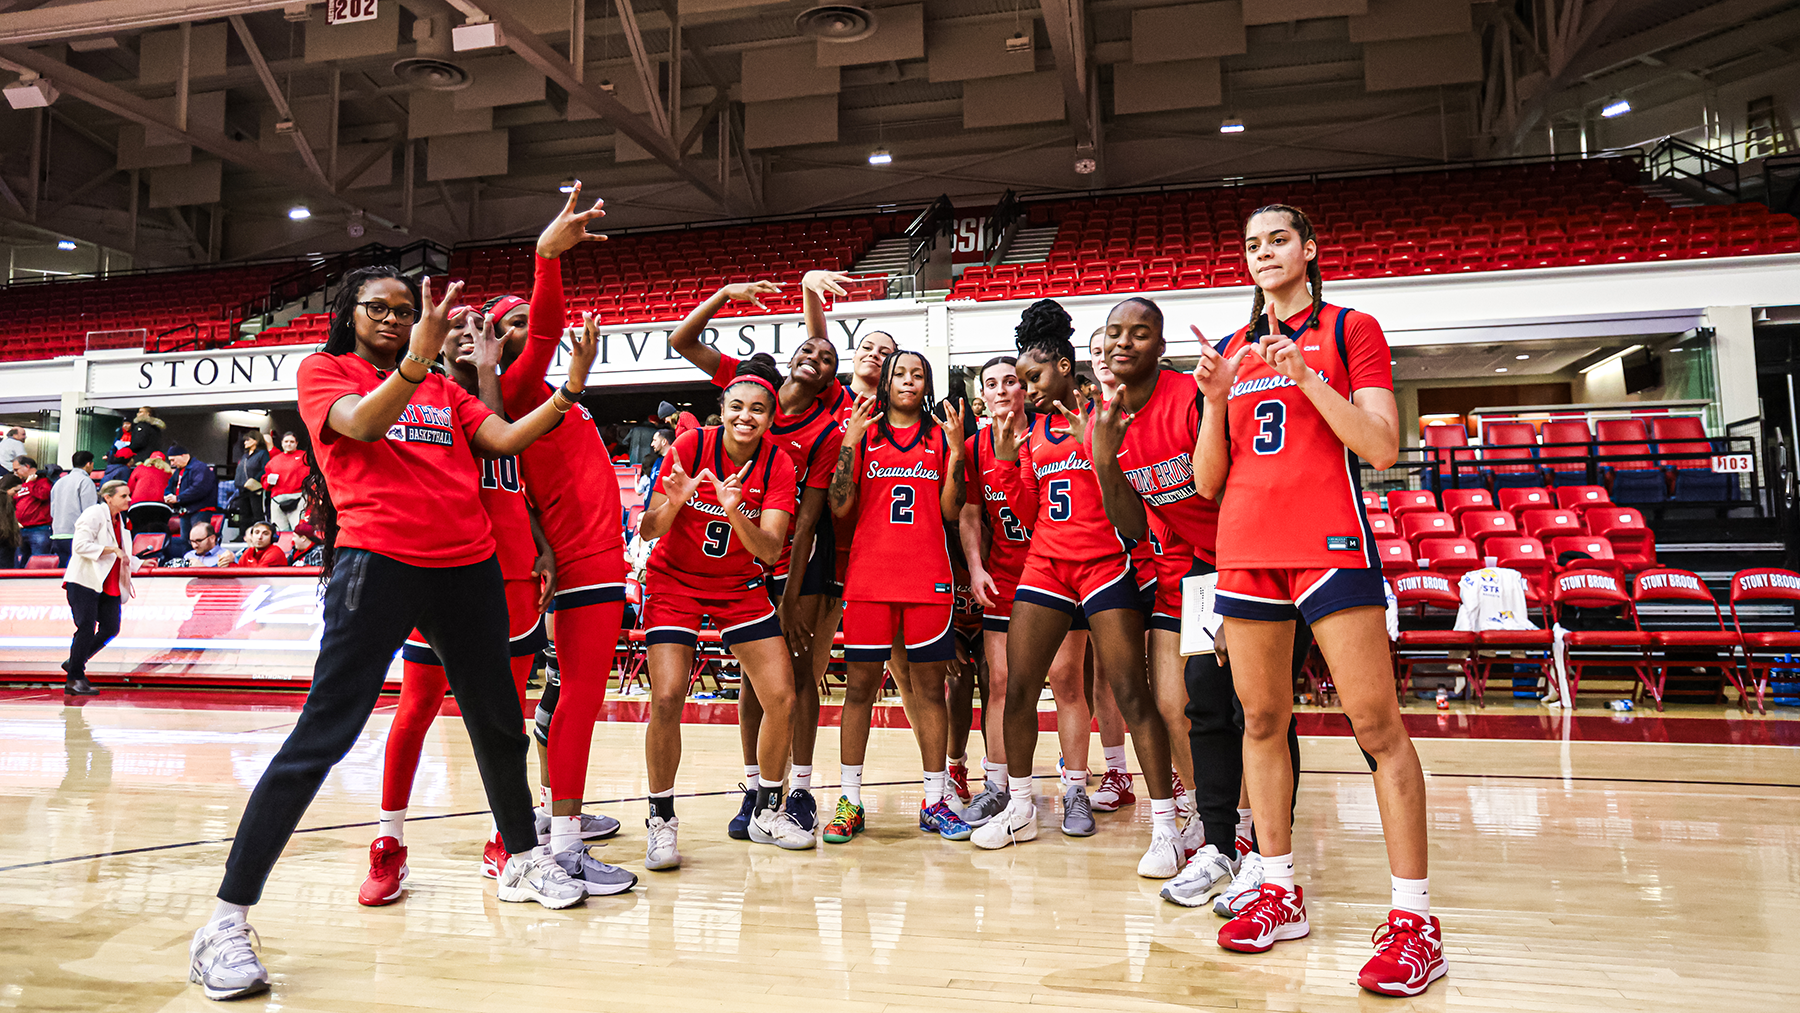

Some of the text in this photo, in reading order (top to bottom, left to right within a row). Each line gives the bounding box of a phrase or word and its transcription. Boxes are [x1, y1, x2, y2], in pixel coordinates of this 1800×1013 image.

[336, 0, 375, 19] 202
[138, 354, 287, 390] STONY
[408, 427, 453, 445] BASKETBALL
[1253, 399, 1286, 455] 3
[482, 454, 521, 493] 10
[866, 460, 940, 481] Seawolves
[1032, 450, 1093, 481] Seawolve
[1123, 452, 1195, 494] TONY BROOK
[1723, 457, 1748, 470] 103
[890, 484, 915, 525] 2
[1048, 478, 1072, 522] 5
[999, 506, 1033, 541] 2
[701, 520, 732, 558] 9
[1397, 576, 1450, 592] STONY BROOK
[1559, 574, 1617, 591] STONY BROOK
[1640, 574, 1700, 590] STONY BROOK
[1739, 573, 1769, 591] STONY
[0, 605, 50, 621] STONY
[121, 605, 195, 621] AWOLVES
